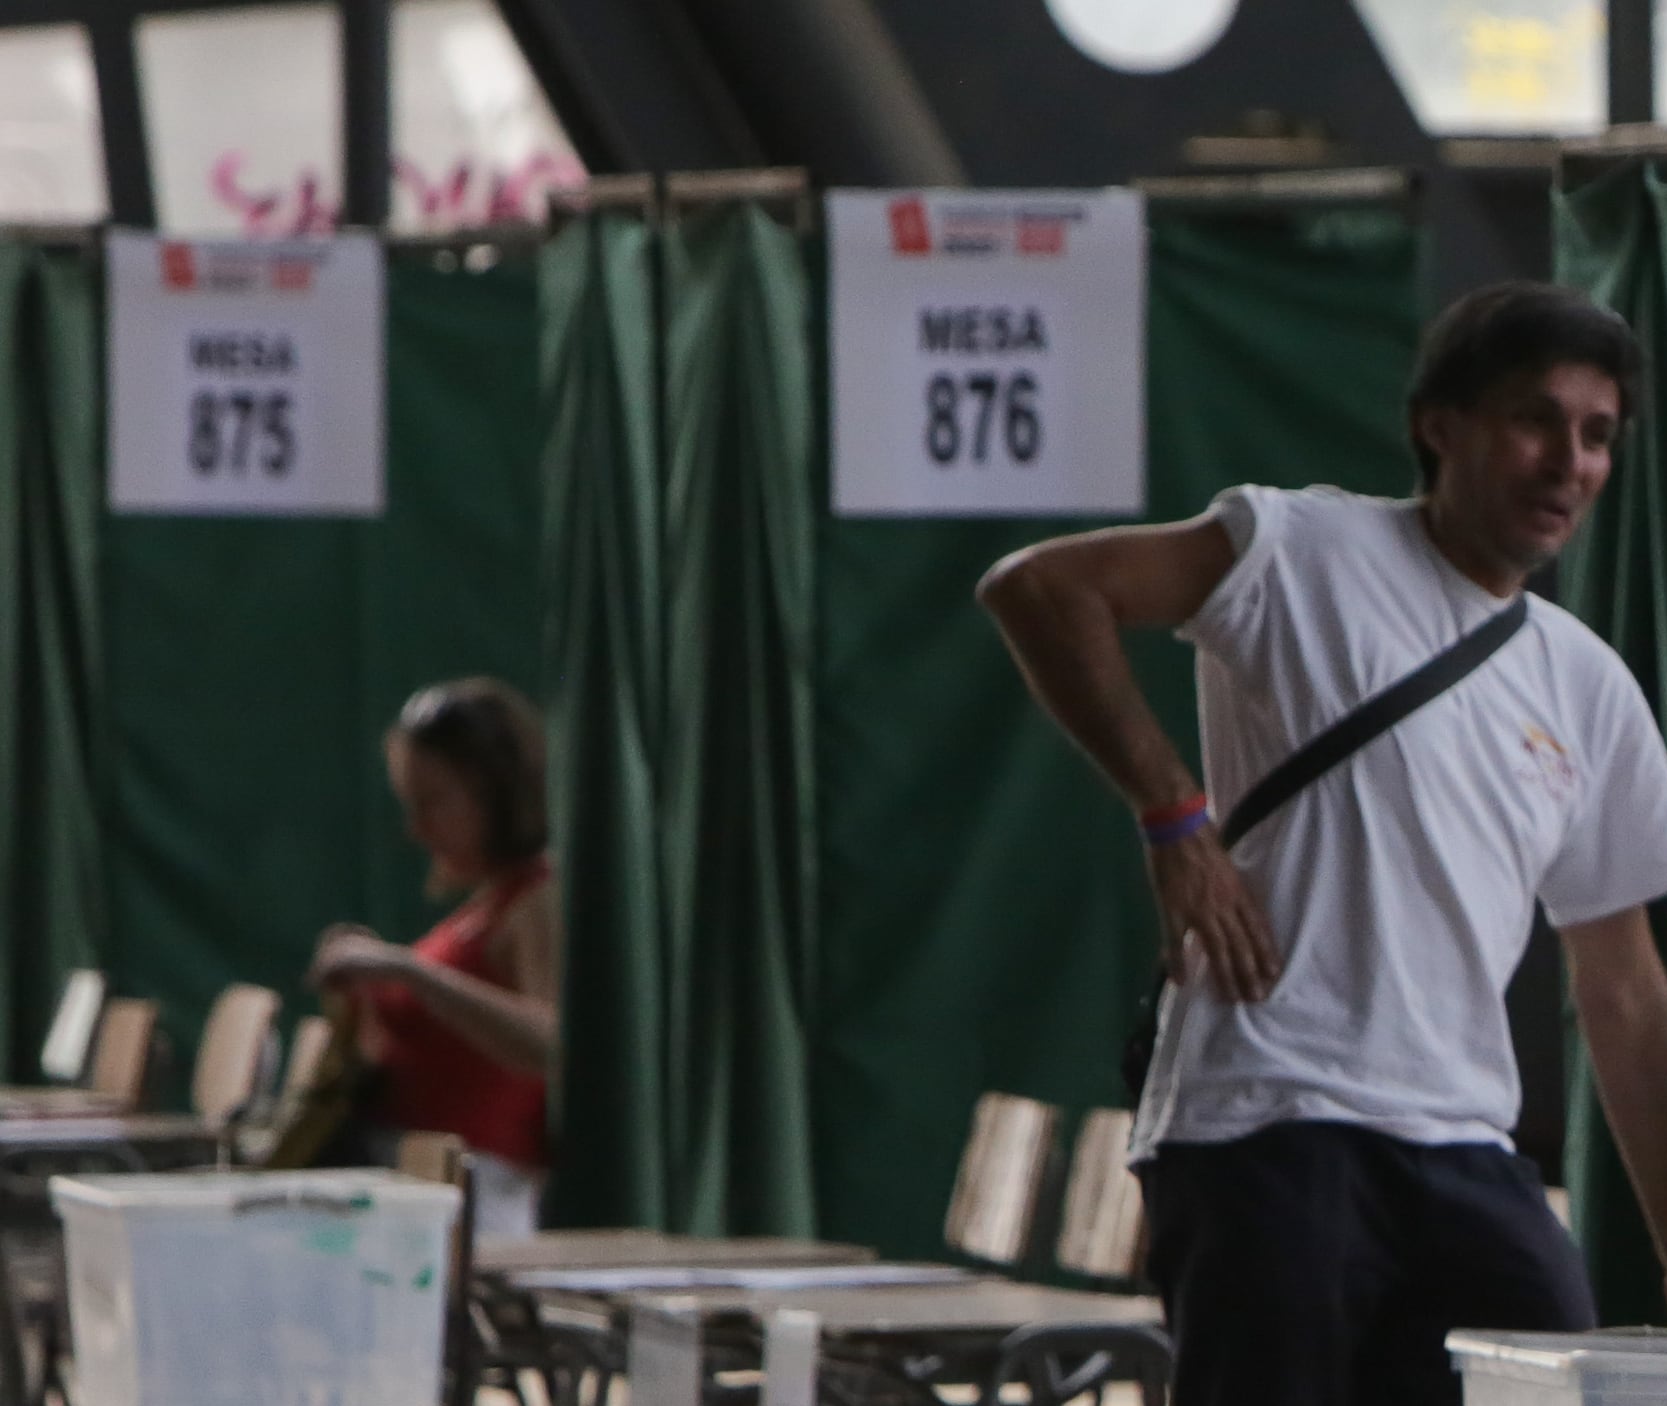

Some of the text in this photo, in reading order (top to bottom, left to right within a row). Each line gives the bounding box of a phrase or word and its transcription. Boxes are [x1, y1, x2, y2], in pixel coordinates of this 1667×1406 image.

[189, 332, 296, 372] MESA
[918, 306, 1048, 353] MESA
[190, 390, 297, 479] 875
[925, 371, 1042, 465] 876
